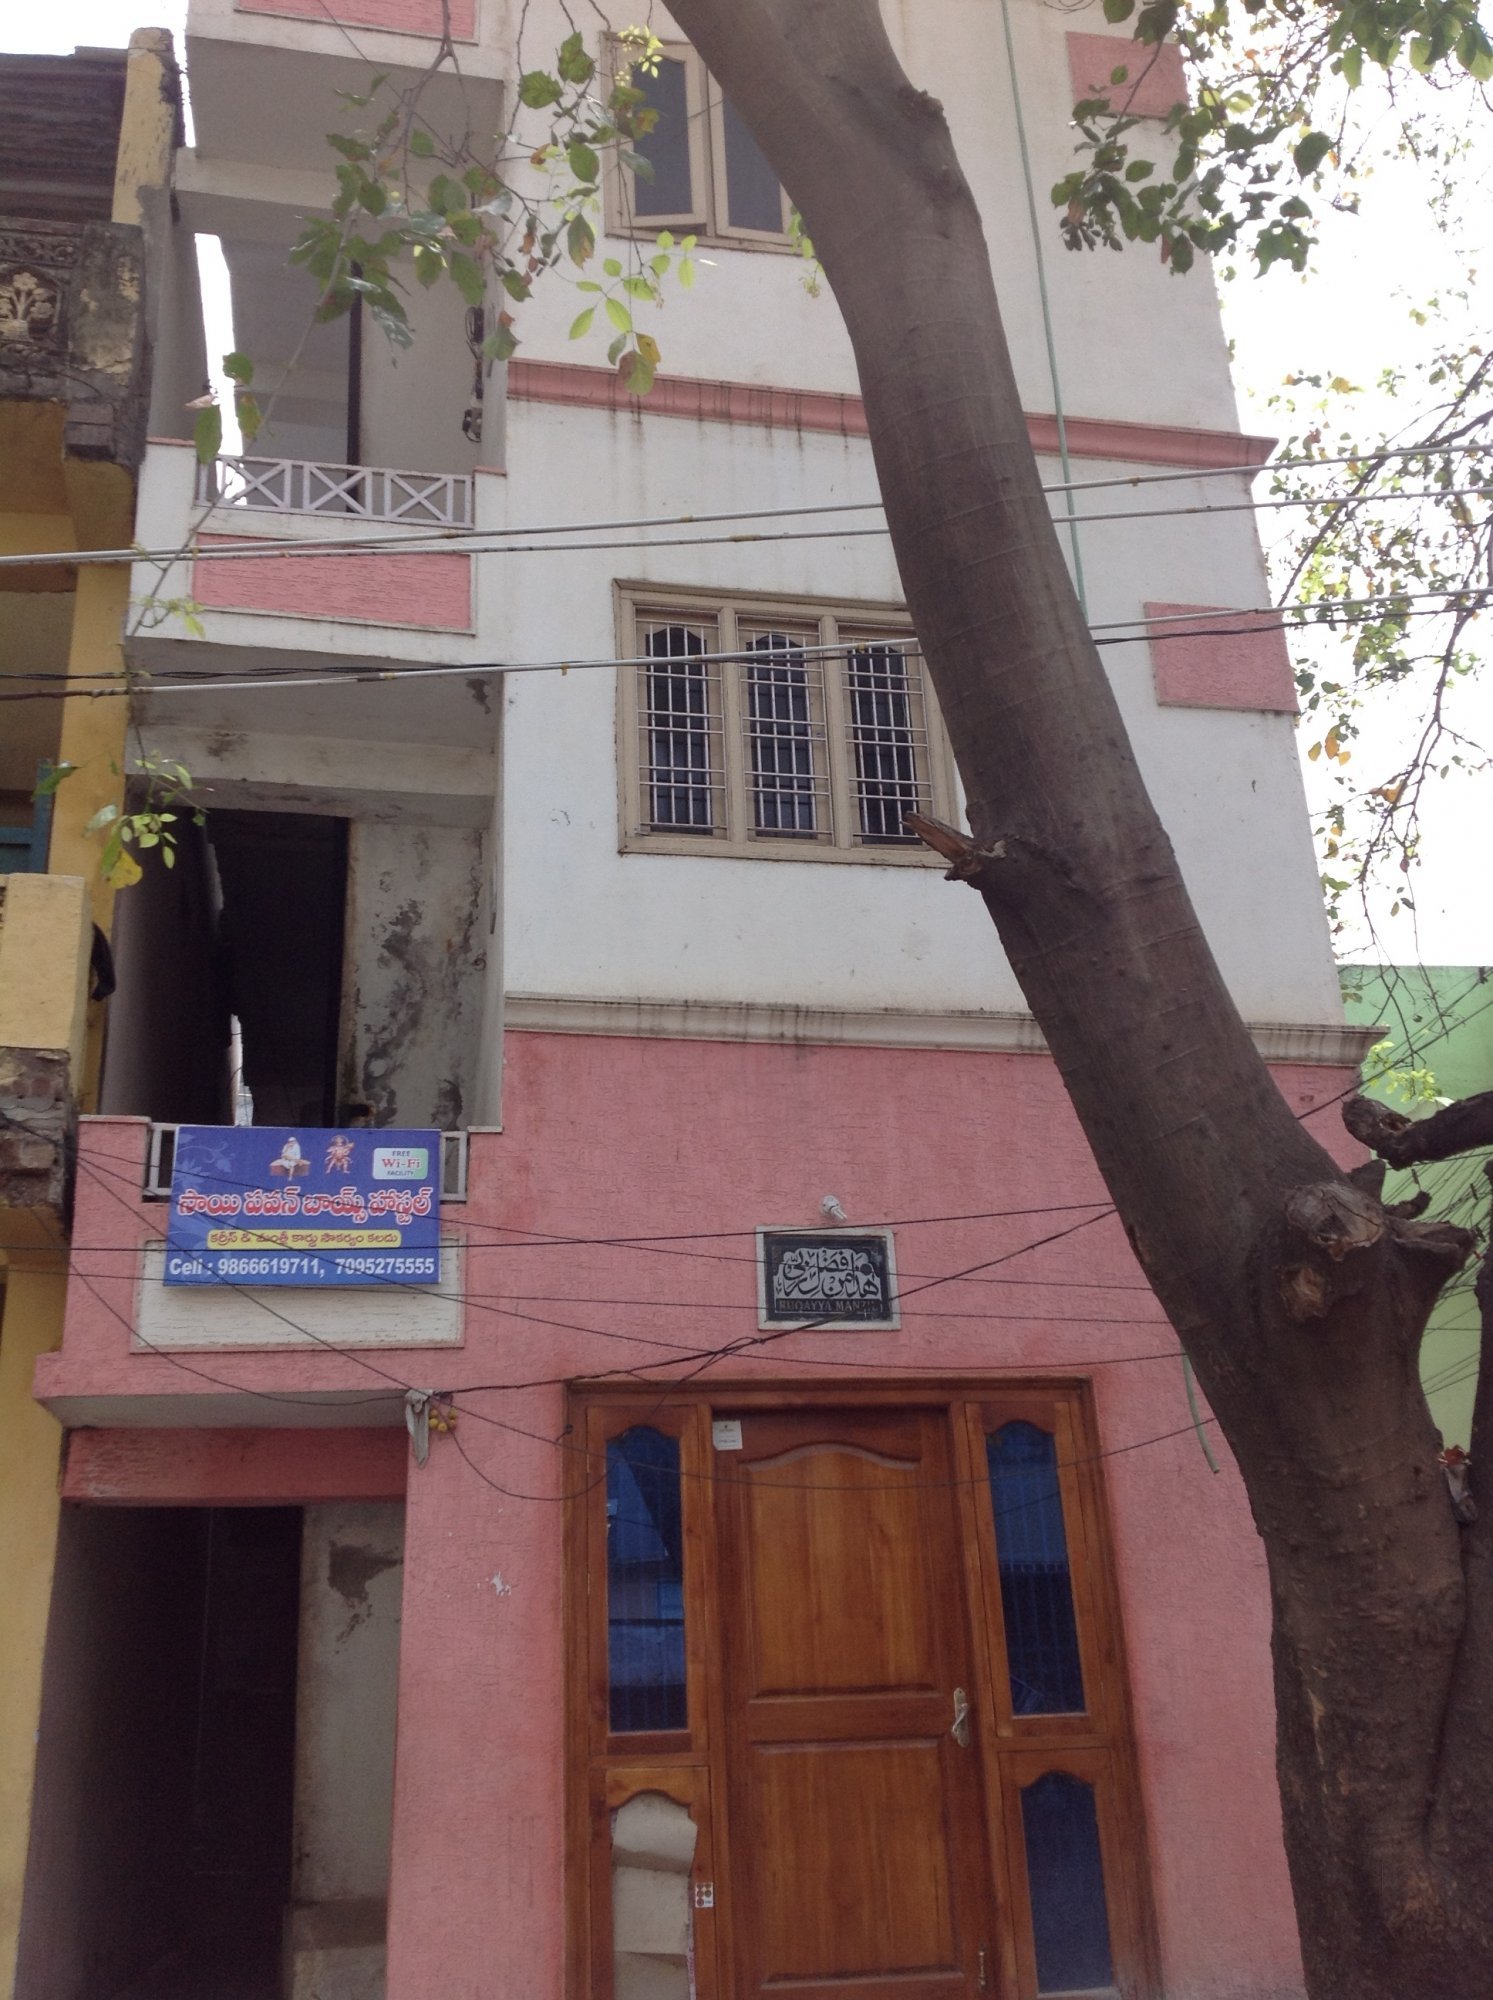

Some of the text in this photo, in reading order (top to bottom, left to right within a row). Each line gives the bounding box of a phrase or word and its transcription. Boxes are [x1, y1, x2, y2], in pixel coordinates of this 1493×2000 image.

[382, 1158, 421, 1168] Wi-Fi
[178, 1188, 242, 1216] సాయి
[243, 1186, 301, 1216] పవన్
[368, 1187, 434, 1225] హాస్టల్
[335, 1257, 435, 1274] 7095275555
